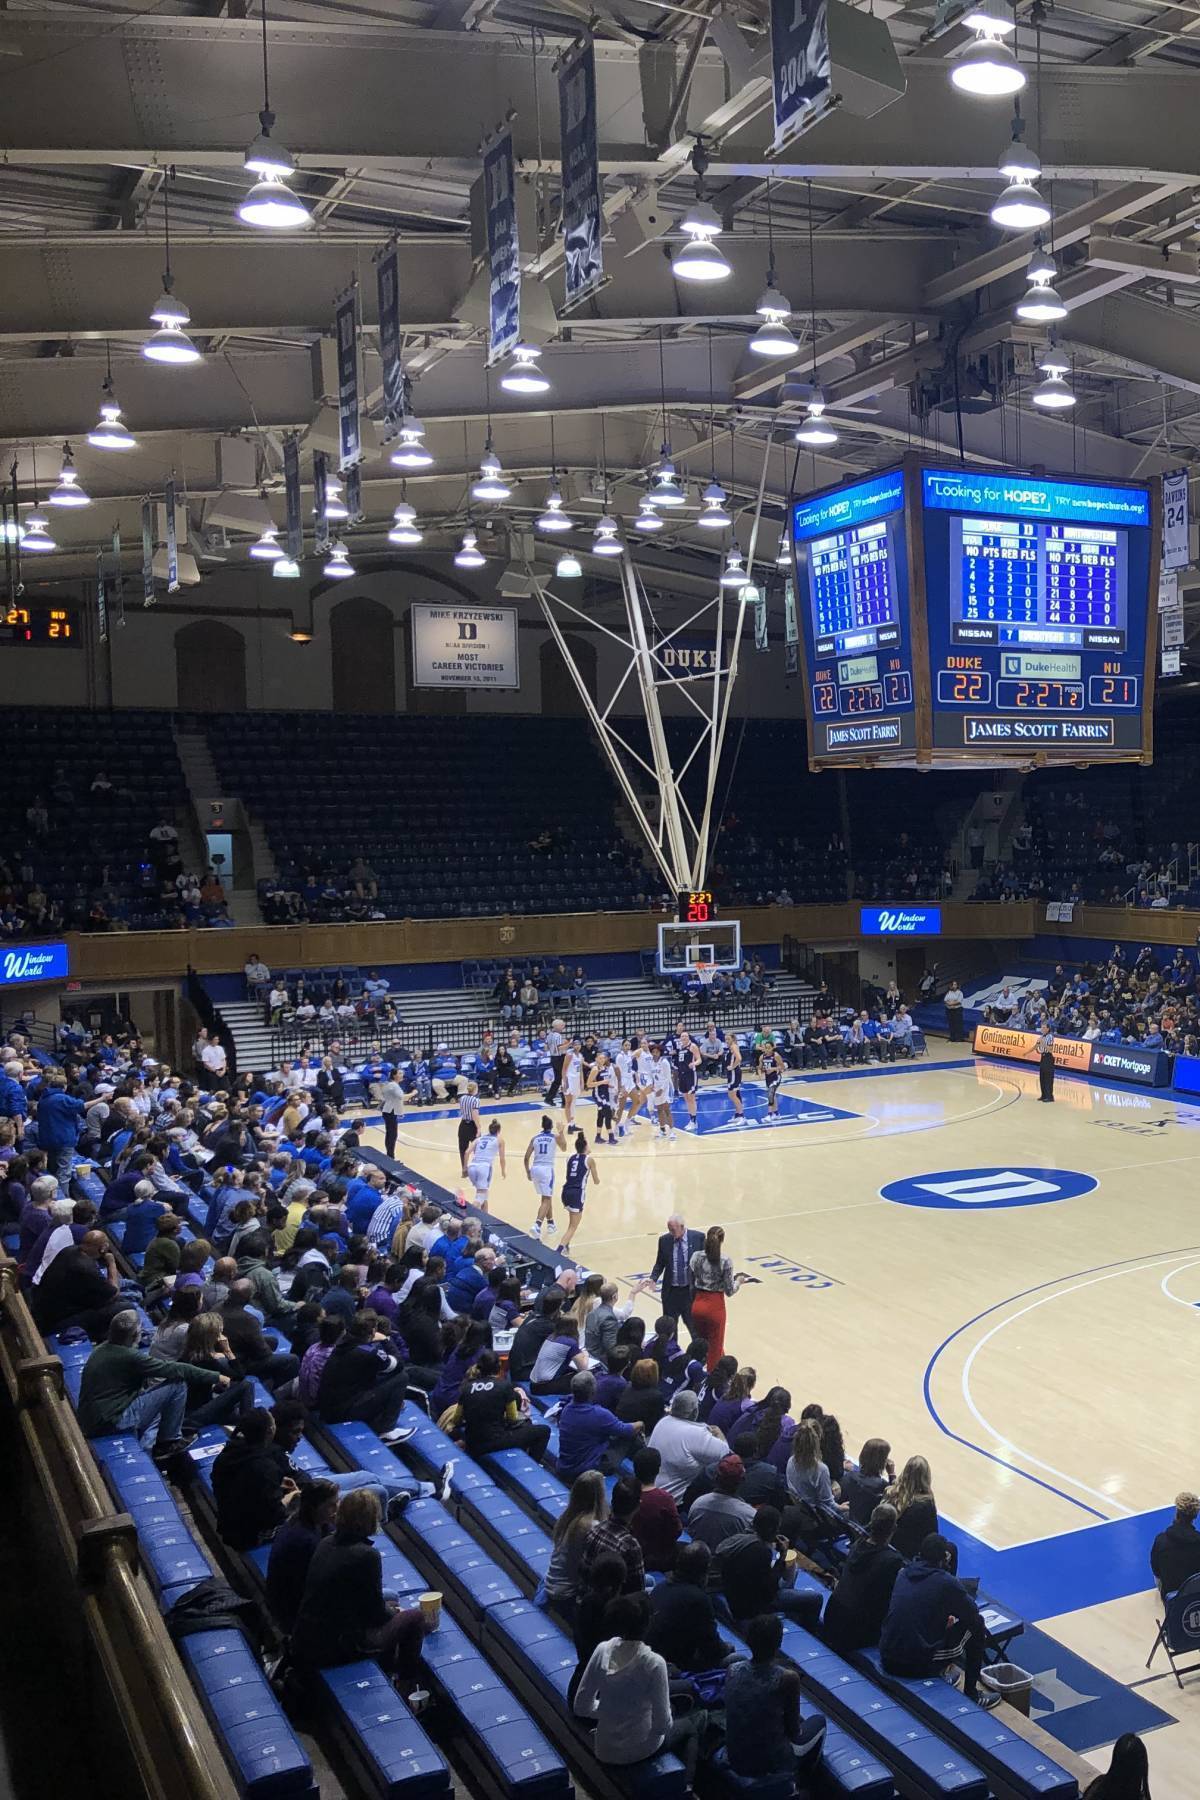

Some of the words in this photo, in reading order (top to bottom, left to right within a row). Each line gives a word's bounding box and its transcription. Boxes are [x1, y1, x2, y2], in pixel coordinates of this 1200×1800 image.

[935, 482, 981, 503] Looking
[983, 487, 1000, 500] for
[1004, 490, 1046, 504] HOPE?
[1054, 496, 1071, 505] TRY
[1167, 505, 1185, 528] 24
[983, 547, 1000, 558] PTS
[1001, 549, 1018, 559] REB
[1020, 550, 1036, 560] FLS
[1065, 553, 1080, 563] PTS
[1082, 554, 1098, 565] REB
[1100, 555, 1115, 566] FLS
[970, 558, 975, 569] 2
[989, 560, 994, 570] 5
[1007, 561, 1012, 571] 2
[1050, 564, 1059, 574] 10
[1069, 565, 1075, 575] 8
[1087, 567, 1093, 577] 3
[1105, 568, 1110, 578] 2
[969, 571, 975, 581] 4
[988, 572, 994, 582] 2
[1007, 573, 1013, 583] 3
[1051, 576, 1059, 586] 12
[1069, 577, 1075, 587] 0
[1105, 580, 1110, 590] 2
[970, 583, 975, 593] 5
[988, 584, 994, 594] 4
[1007, 586, 1012, 596] 2
[1025, 587, 1031, 597] 0
[1051, 589, 1059, 599] 21
[1069, 589, 1075, 599] 8
[1087, 591, 1092, 600] 4
[1104, 591, 1110, 602] 0
[968, 595, 977, 606] 15
[988, 596, 994, 607] 0
[1025, 599, 1031, 609] 0
[1049, 600, 1060, 610] 24
[1070, 601, 1075, 611] 3
[1104, 603, 1110, 613] 0
[430, 611, 451, 619] MIKE
[453, 611, 503, 621] KRZYZEWSKI
[967, 608, 978, 618] 25
[988, 609, 994, 619] 6
[1007, 610, 1012, 620] 2
[1025, 611, 1031, 621] 2
[1049, 612, 1060, 622] 44
[1069, 613, 1075, 623] 0
[1104, 615, 1110, 625] 0
[48, 623, 70, 637] 21
[958, 629, 993, 639] NISSAN
[1088, 635, 1120, 644] NISSAN
[457, 653, 479, 661] MOST
[947, 656, 982, 670] DUKE
[432, 662, 463, 670] CAREER
[465, 663, 504, 671] VICTORIES
[1025, 661, 1077, 673] DukeHealth
[1103, 663, 1121, 674] NU
[815, 670, 832, 681] DUKE
[891, 677, 907, 701] 21
[954, 675, 982, 700] 22
[1102, 679, 1128, 703] 21
[820, 686, 833, 710] 22
[848, 687, 873, 712] 2:27
[1016, 683, 1063, 707] 2:27
[1070, 692, 1077, 706] 2
[829, 729, 849, 746] JAMES
[849, 727, 872, 740] SCOTT
[872, 724, 898, 739] FARRIN
[969, 722, 1011, 739] JAMES
[1014, 723, 1058, 737] SCOTT
[1062, 724, 1109, 738] FARRIN
[689, 892, 712, 904] 2:27
[687, 904, 708, 922] 20
[981, 1028, 1020, 1047] Continental
[991, 1045, 1011, 1056] TIRE
[1093, 1053, 1121, 1067] ROCKET
[479, 1141, 487, 1150] 3
[538, 1143, 548, 1154] 11
[571, 1160, 579, 1172] 3
[745, 1254, 833, 1290] COURT
[470, 1381, 494, 1395] 100
